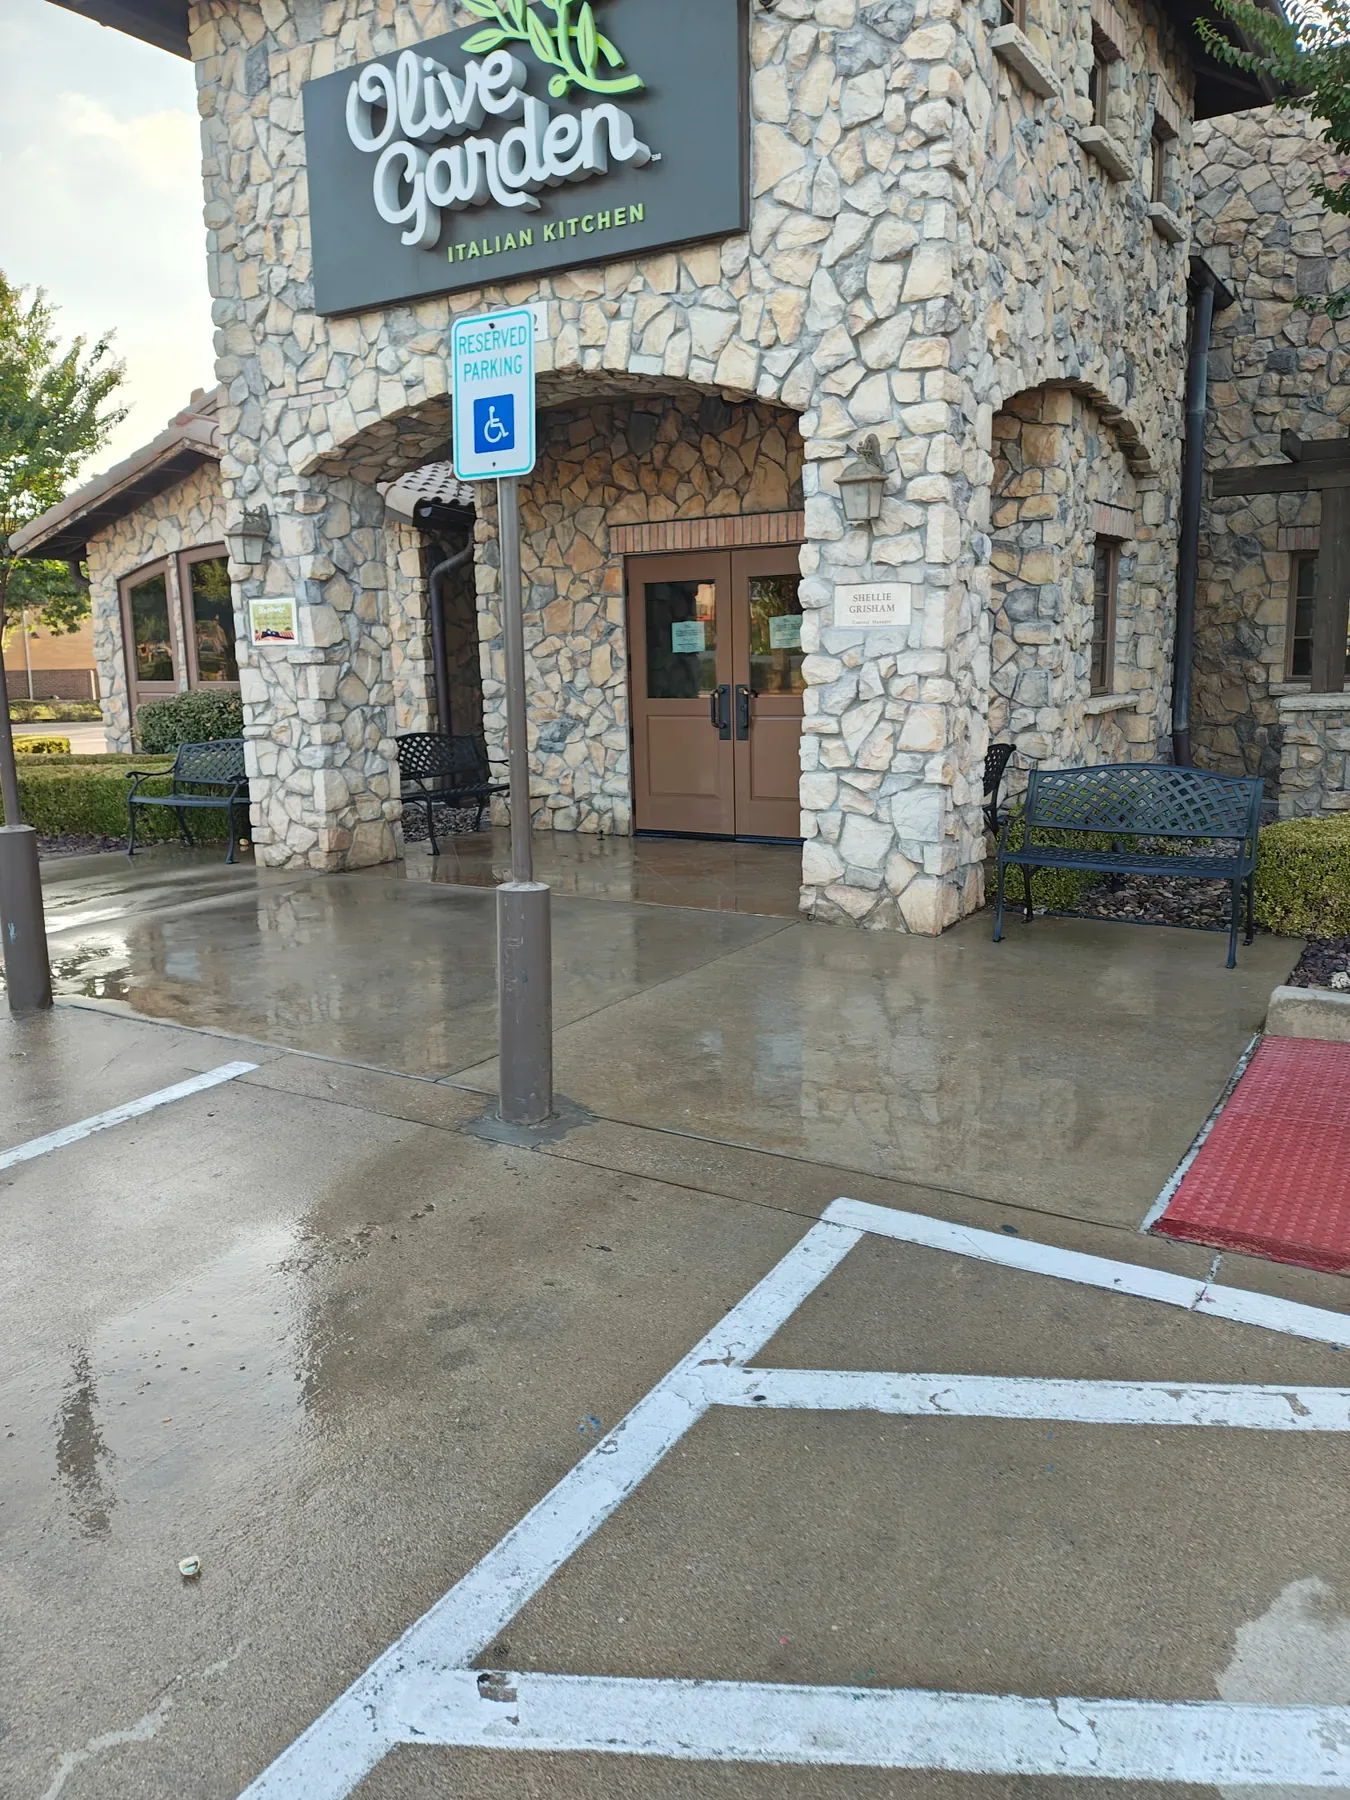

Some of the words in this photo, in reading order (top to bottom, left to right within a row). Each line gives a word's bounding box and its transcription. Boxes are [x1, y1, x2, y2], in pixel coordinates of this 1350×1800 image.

[346, 49, 527, 152] Olive
[373, 95, 651, 249] Garden
[447, 228, 534, 263] ITALIAN
[543, 203, 645, 242] KITCHEN
[459, 325, 527, 355] RESERVED
[463, 354, 523, 382] PARKING
[848, 603, 895, 614] GRISHAM
[852, 592, 892, 602] SHELLIE
